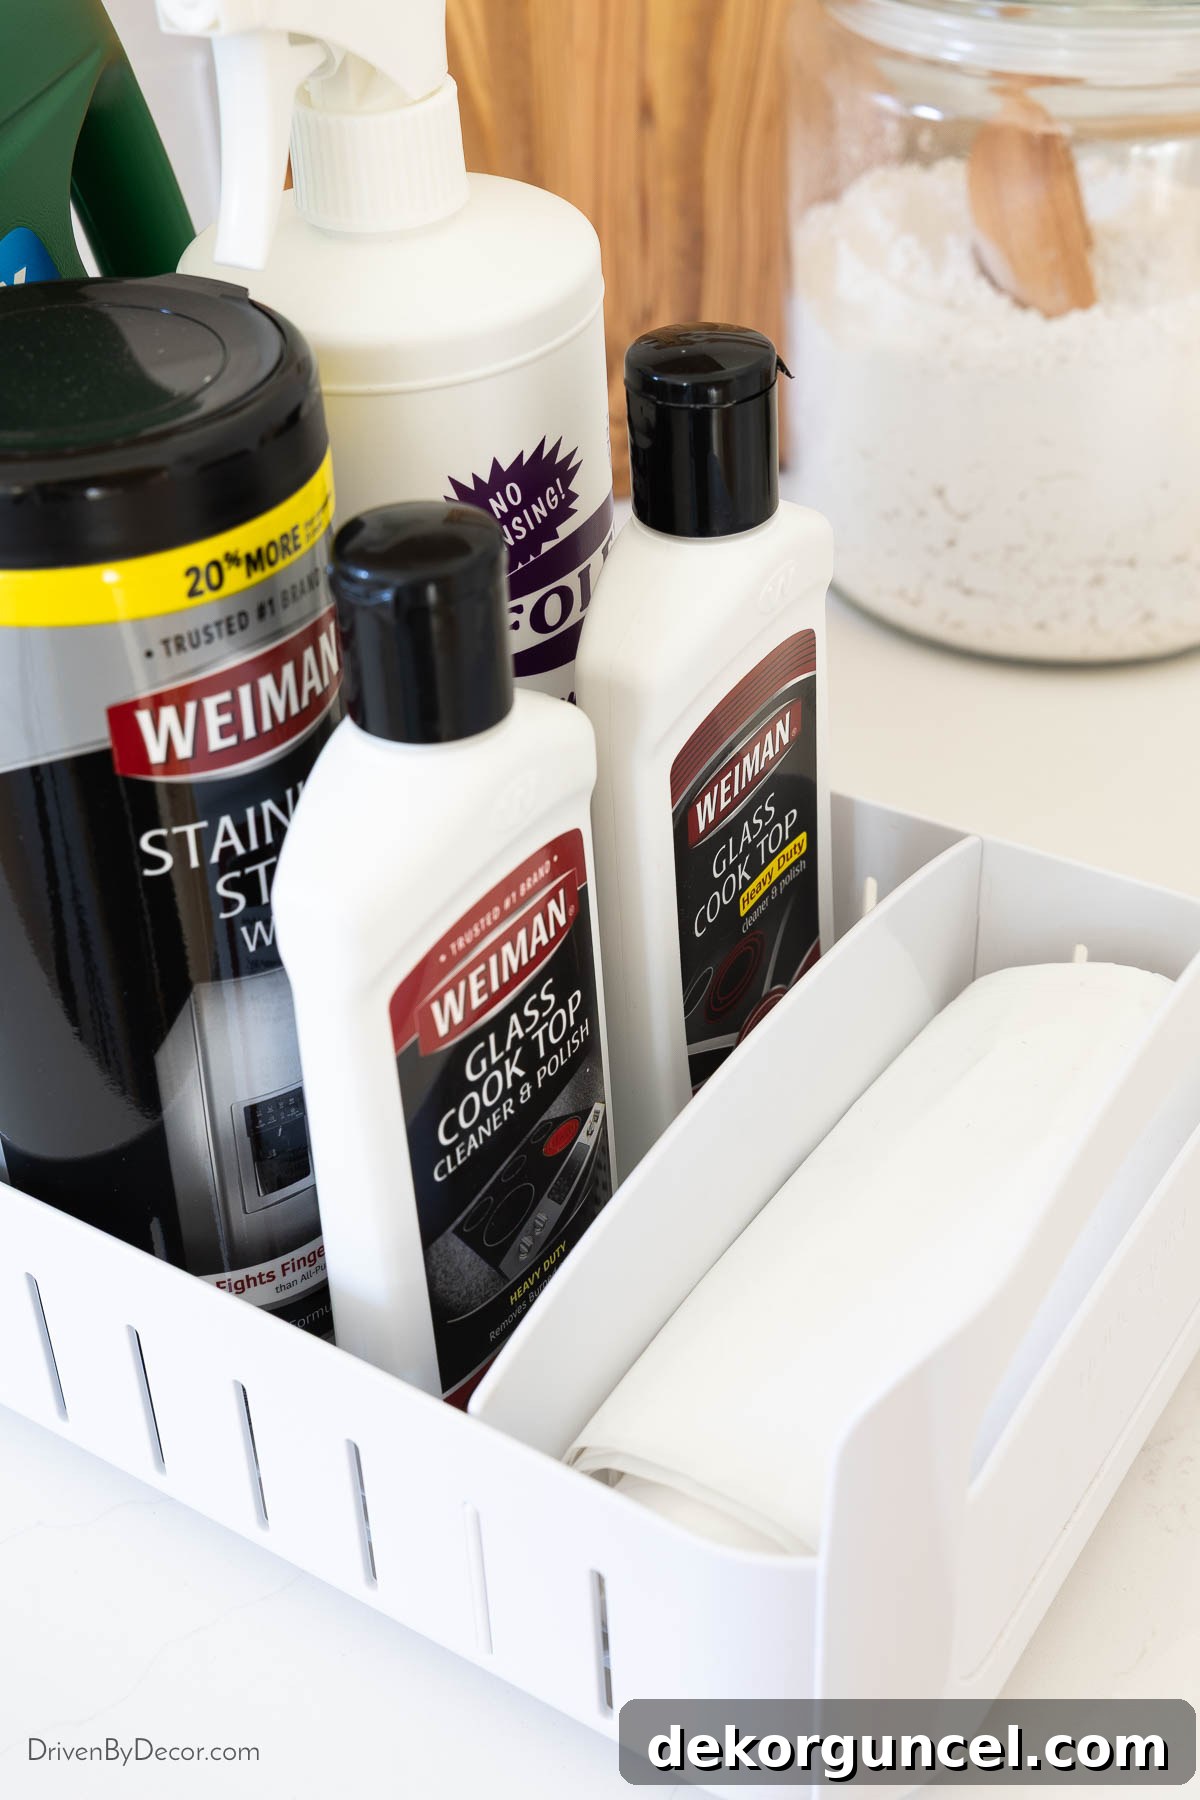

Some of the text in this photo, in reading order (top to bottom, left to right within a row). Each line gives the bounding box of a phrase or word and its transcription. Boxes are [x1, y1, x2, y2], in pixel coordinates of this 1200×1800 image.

[488, 482, 522, 519] NO
[502, 477, 566, 546] NSING!
[245, 525, 302, 578] MORE
[161, 567, 321, 657] TRUSTED #1 BRAND
[134, 621, 341, 764] WEIMAN
[696, 710, 792, 834] WEIMAN
[139, 782, 303, 876] STAIN
[712, 792, 775, 878] GLASS
[216, 857, 277, 919] ST
[449, 860, 551, 956] TRUSTED #1 BRAND
[694, 809, 797, 937] COOK TOP
[741, 839, 805, 910] Heavy Duty
[742, 860, 806, 933] cleaner & polish
[430, 888, 567, 1038] WEIMAN
[437, 989, 582, 1147] COOK TOP
[465, 978, 556, 1082] GLASS
[433, 1018, 590, 1182] CLEANER & POLISH
[215, 1244, 326, 1294] Fights Finge
[275, 1264, 327, 1294] than All-Pu
[509, 1240, 566, 1306] HEAVY DUTY
[289, 1304, 332, 1328] Formu
[489, 1301, 527, 1342] Removes
